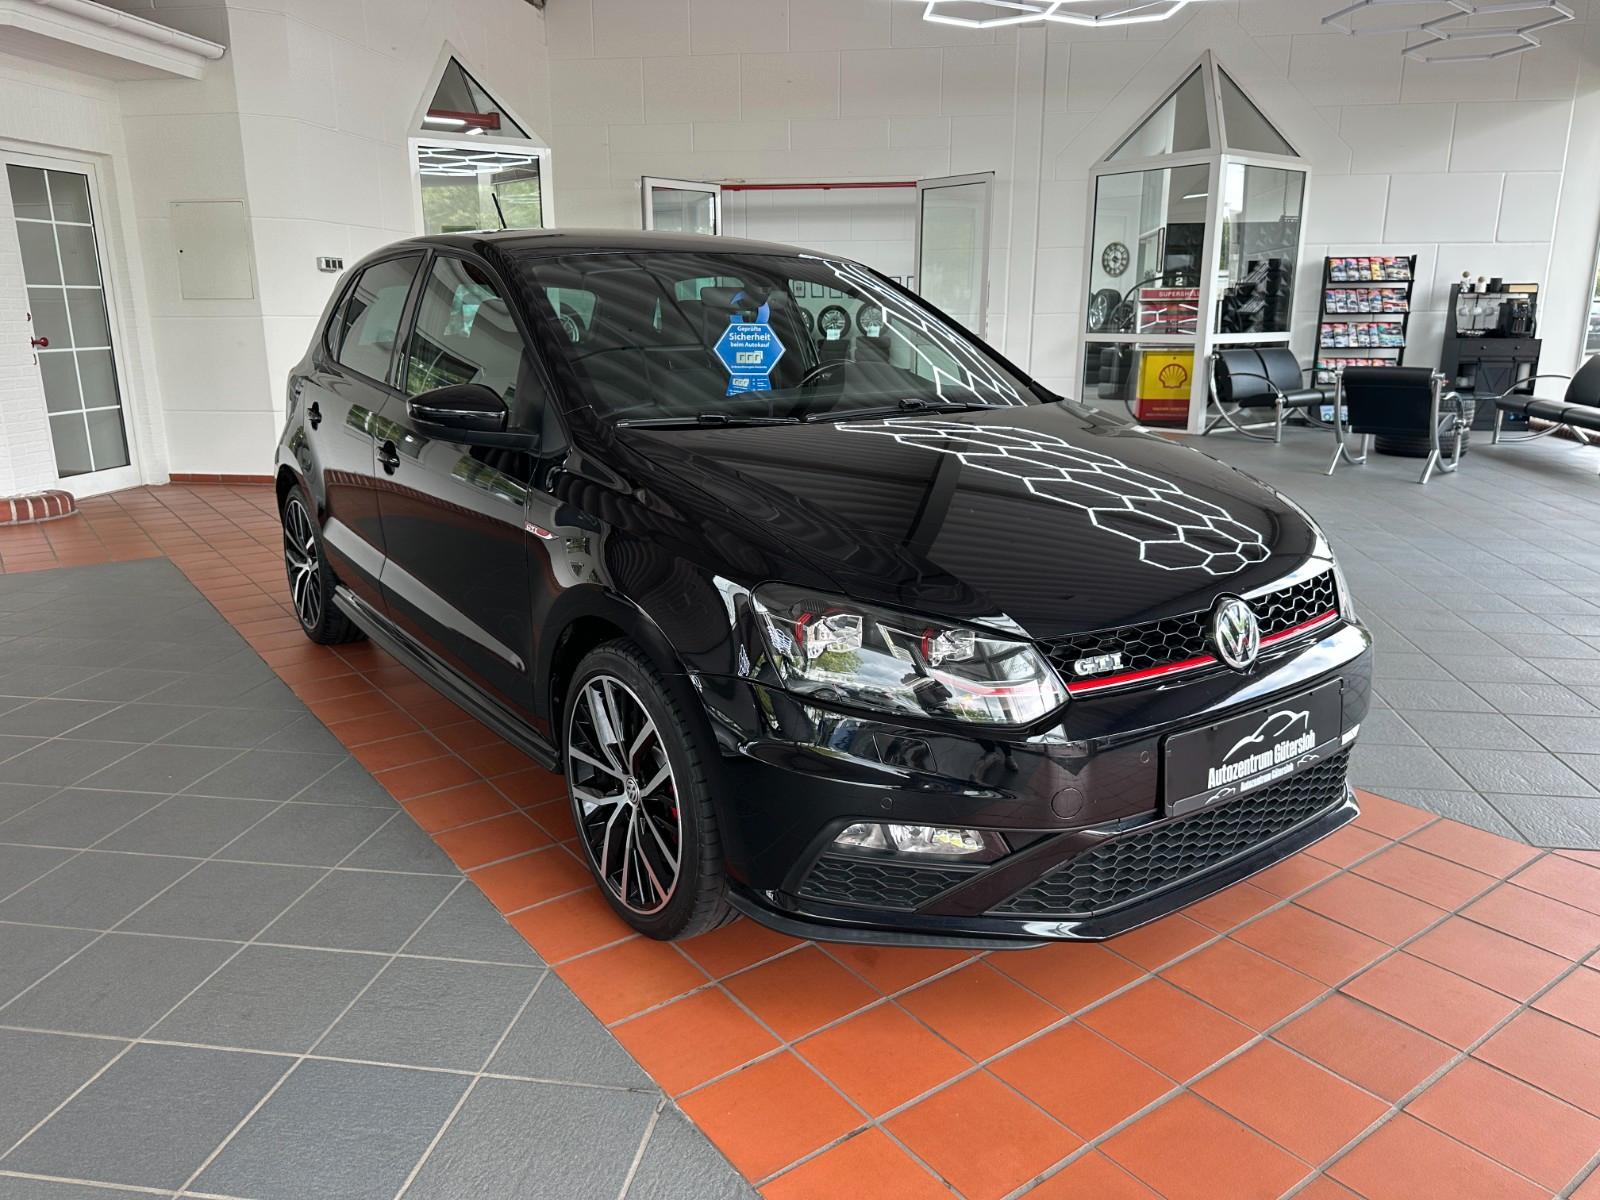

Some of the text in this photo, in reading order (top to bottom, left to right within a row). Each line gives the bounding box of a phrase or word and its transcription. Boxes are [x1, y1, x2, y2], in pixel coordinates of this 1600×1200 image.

[1175, 276, 1184, 287] 2
[729, 332, 770, 341] Sicherheit
[1074, 652, 1124, 676] GTI
[1207, 729, 1315, 789] Autozentrum Gütersloh
